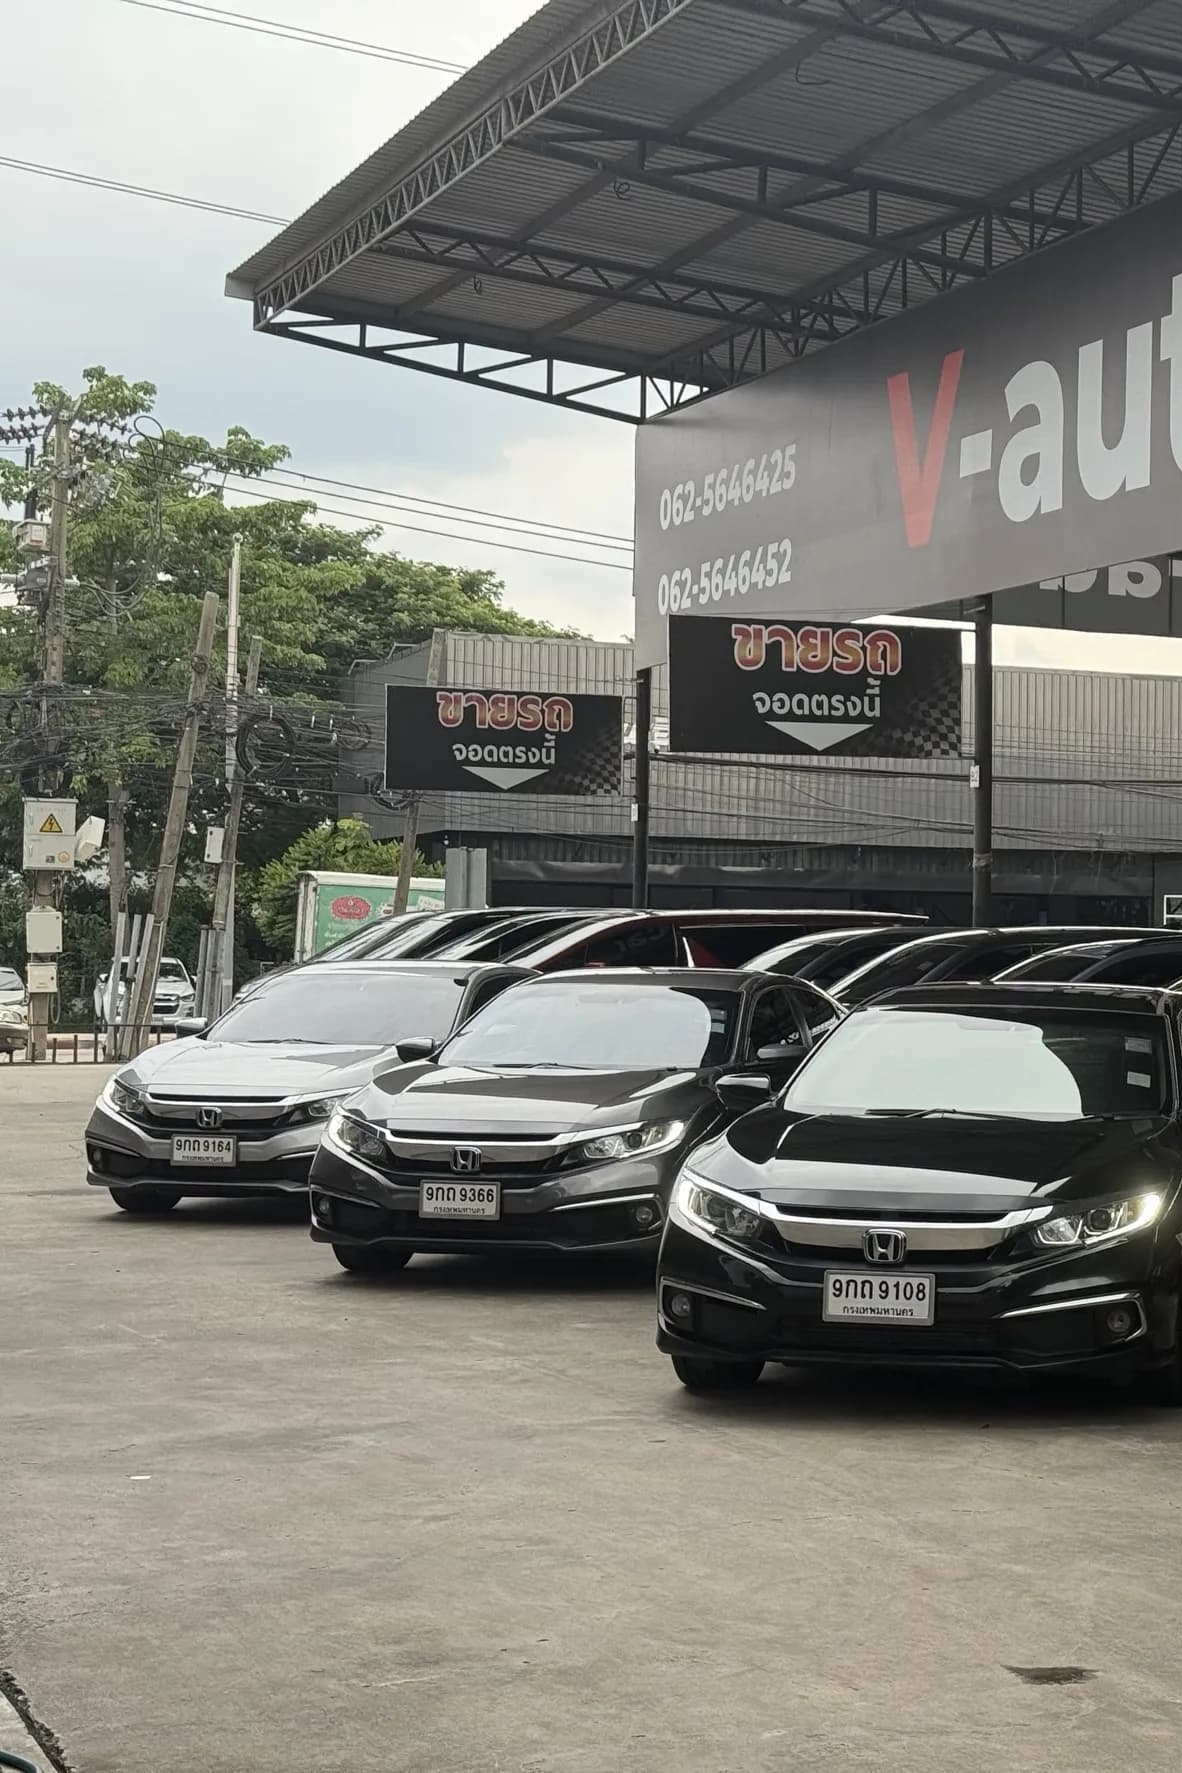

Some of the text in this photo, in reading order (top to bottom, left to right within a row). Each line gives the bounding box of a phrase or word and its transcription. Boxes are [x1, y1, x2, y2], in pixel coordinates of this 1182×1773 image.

[659, 443, 796, 530] 062-5646425
[657, 538, 792, 616] 062-5646452
[731, 624, 902, 676] ขายรถ
[436, 691, 574, 732] ขายรถ
[752, 677, 881, 718] จอดตรงนี้
[452, 733, 556, 764] จอดตรงนี้
[203, 1140, 231, 1153] 9164
[426, 1186, 495, 1203] 9กถ 9366
[832, 1278, 926, 1302] 9กถ 9108
